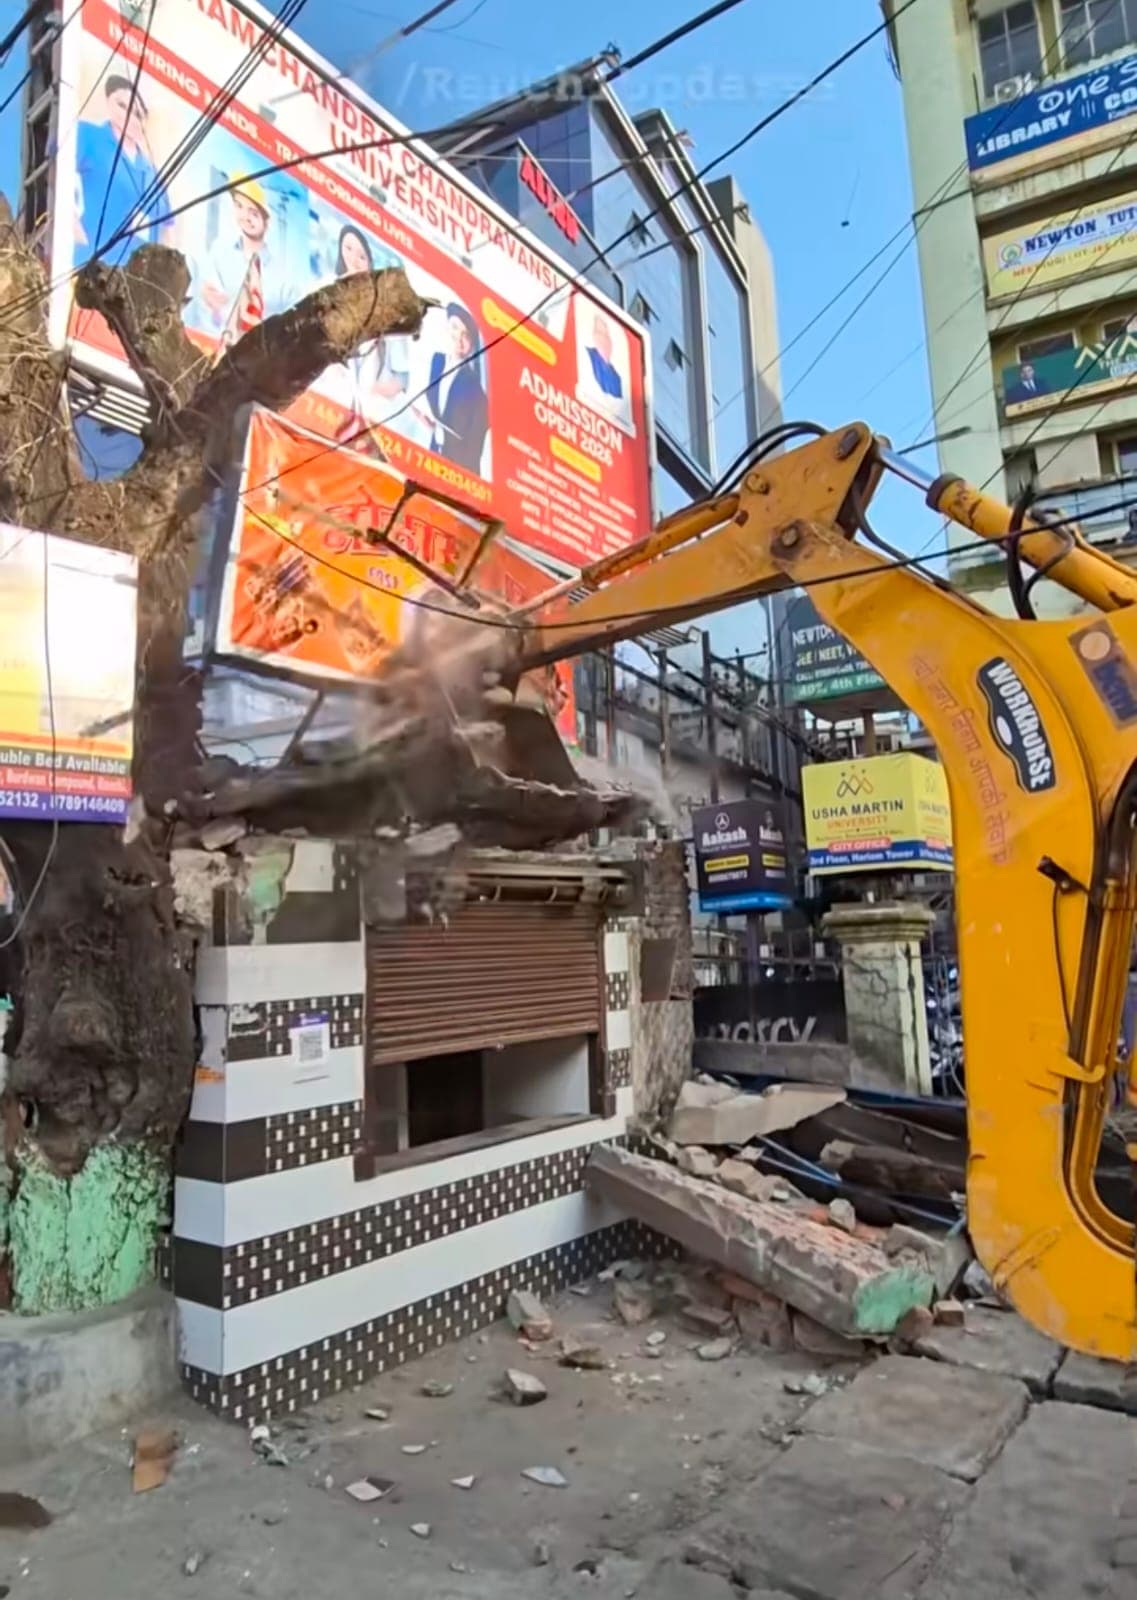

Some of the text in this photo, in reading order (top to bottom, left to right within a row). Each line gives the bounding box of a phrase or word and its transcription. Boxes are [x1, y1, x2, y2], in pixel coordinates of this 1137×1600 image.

[1037, 75, 1111, 113] One
[108, 21, 200, 97] INSPIRING
[275, 140, 383, 228] TRANSFORMING
[976, 110, 1072, 157] LIBRARY
[330, 122, 473, 253] UNIVERSITY
[402, 149, 561, 292] CHANDRAVANSI
[1024, 219, 1097, 252] NEWTON
[519, 366, 623, 454] ADMISSION
[533, 402, 577, 444] OPEN
[35, 752, 63, 769] Bed
[65, 753, 127, 775] Available
[812, 805, 848, 820] USHA
[851, 800, 904, 815] MARTIN
[827, 815, 889, 830] UNIVERSITY
[702, 826, 747, 847] Aakash
